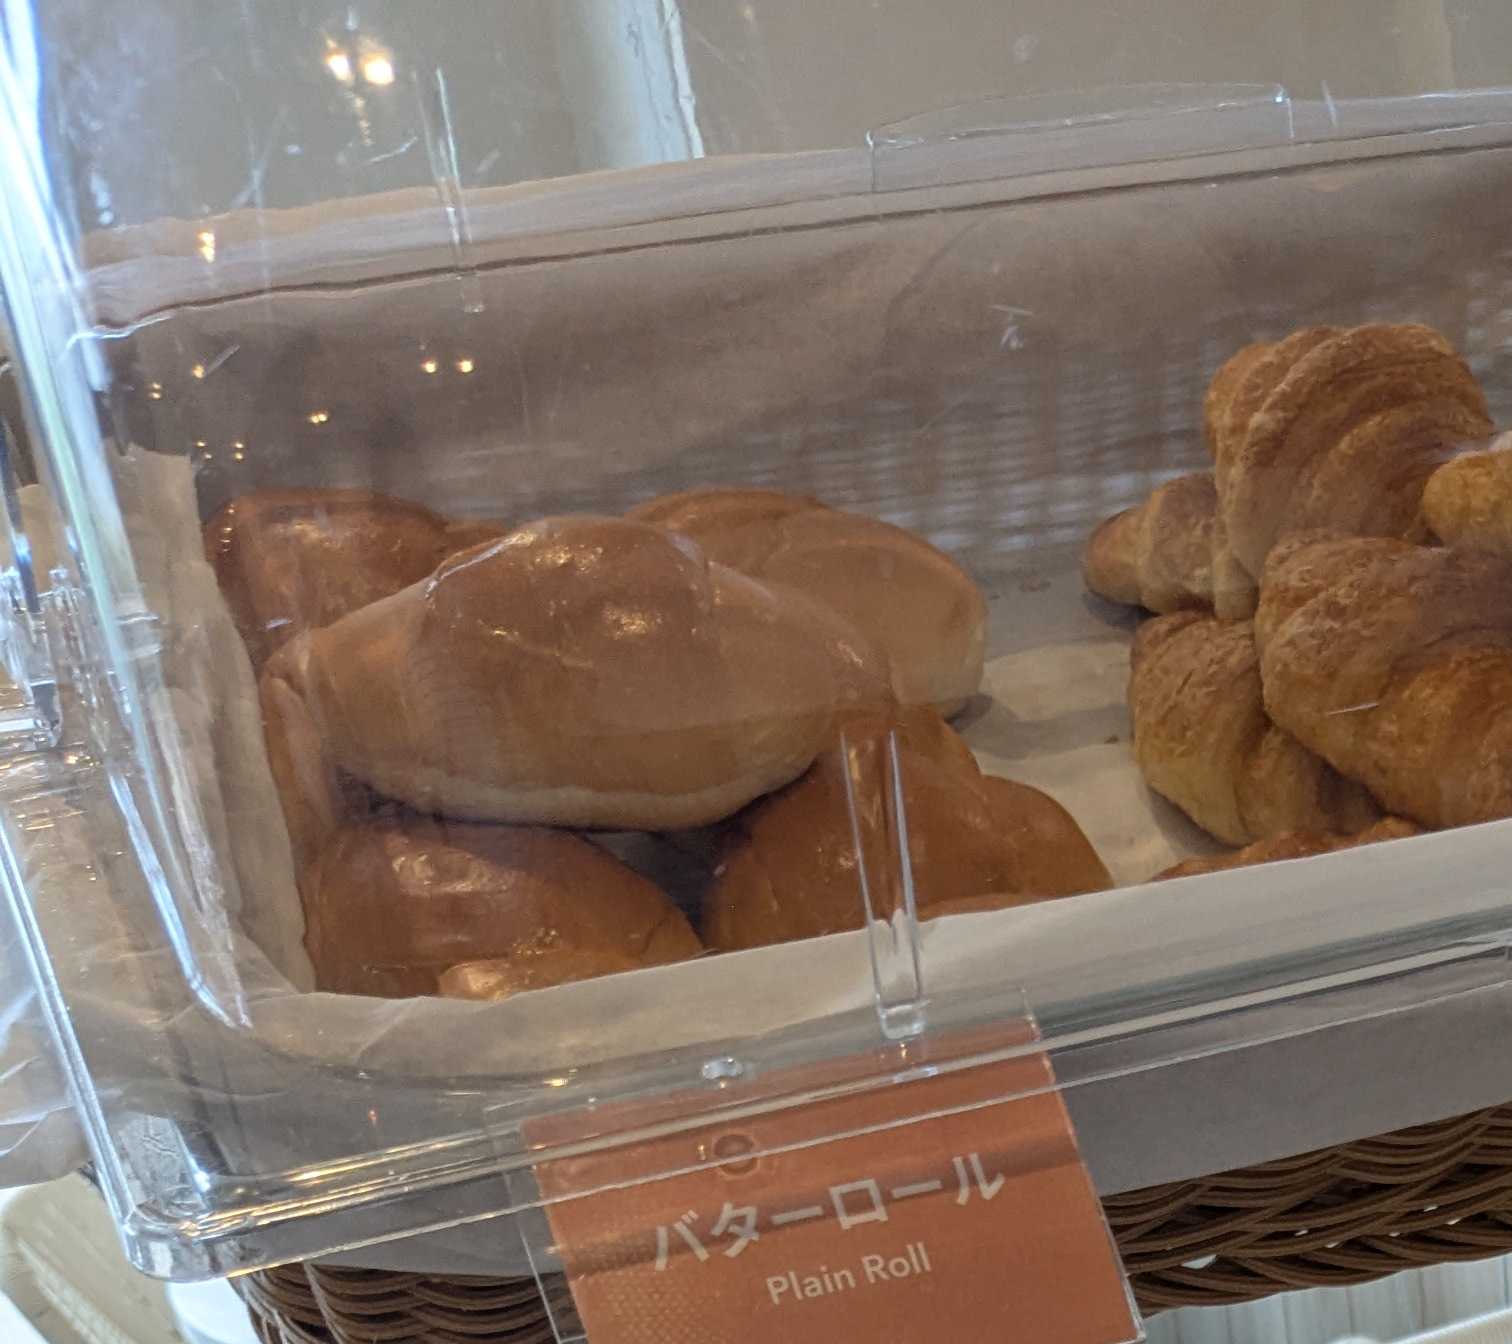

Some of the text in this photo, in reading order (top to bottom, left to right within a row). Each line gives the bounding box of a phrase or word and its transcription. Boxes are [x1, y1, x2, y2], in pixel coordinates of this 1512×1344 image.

[654, 1152, 1006, 1272] バターロール
[766, 1241, 932, 1305] Plain Roll
